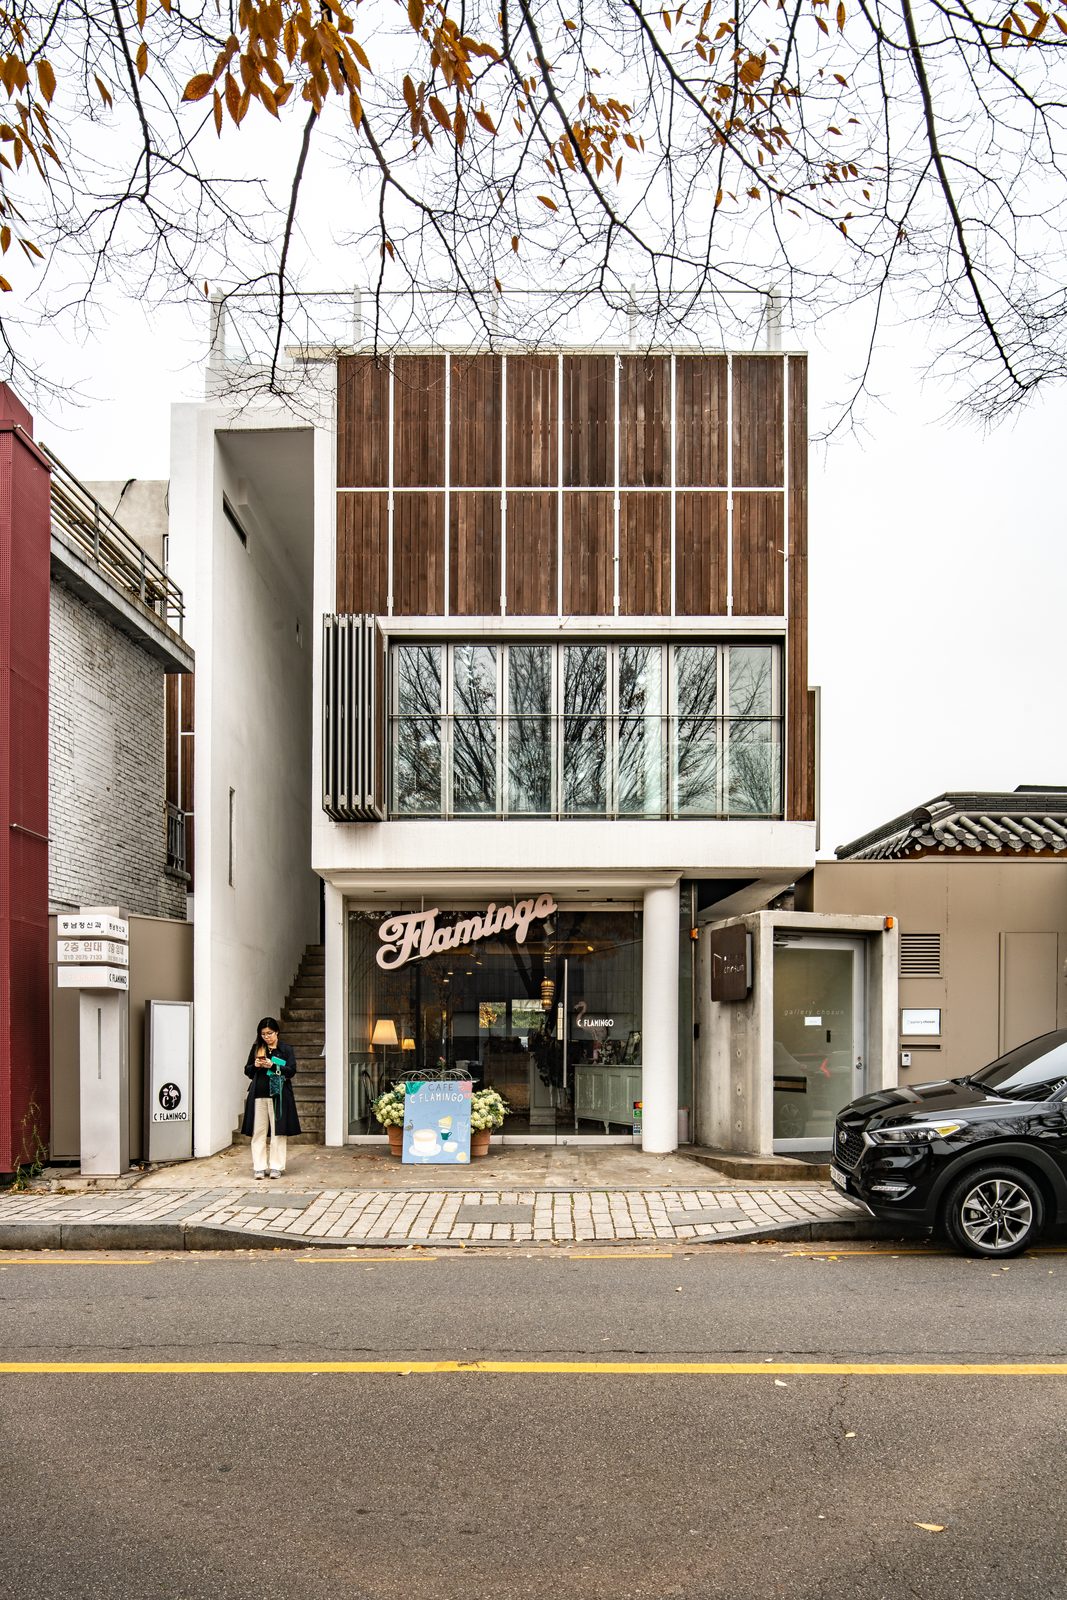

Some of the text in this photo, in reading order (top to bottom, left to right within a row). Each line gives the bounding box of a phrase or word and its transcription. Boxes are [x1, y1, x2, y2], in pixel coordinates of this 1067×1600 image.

[376, 893, 558, 969] Flamingo
[63, 942, 102, 952] 2층 임대
[583, 1018, 614, 1027] FLAMINGO
[428, 1083, 454, 1092] CAFE
[410, 1092, 464, 1104] C FLAMINGO
[154, 1112, 187, 1121] C FLAMINGO
